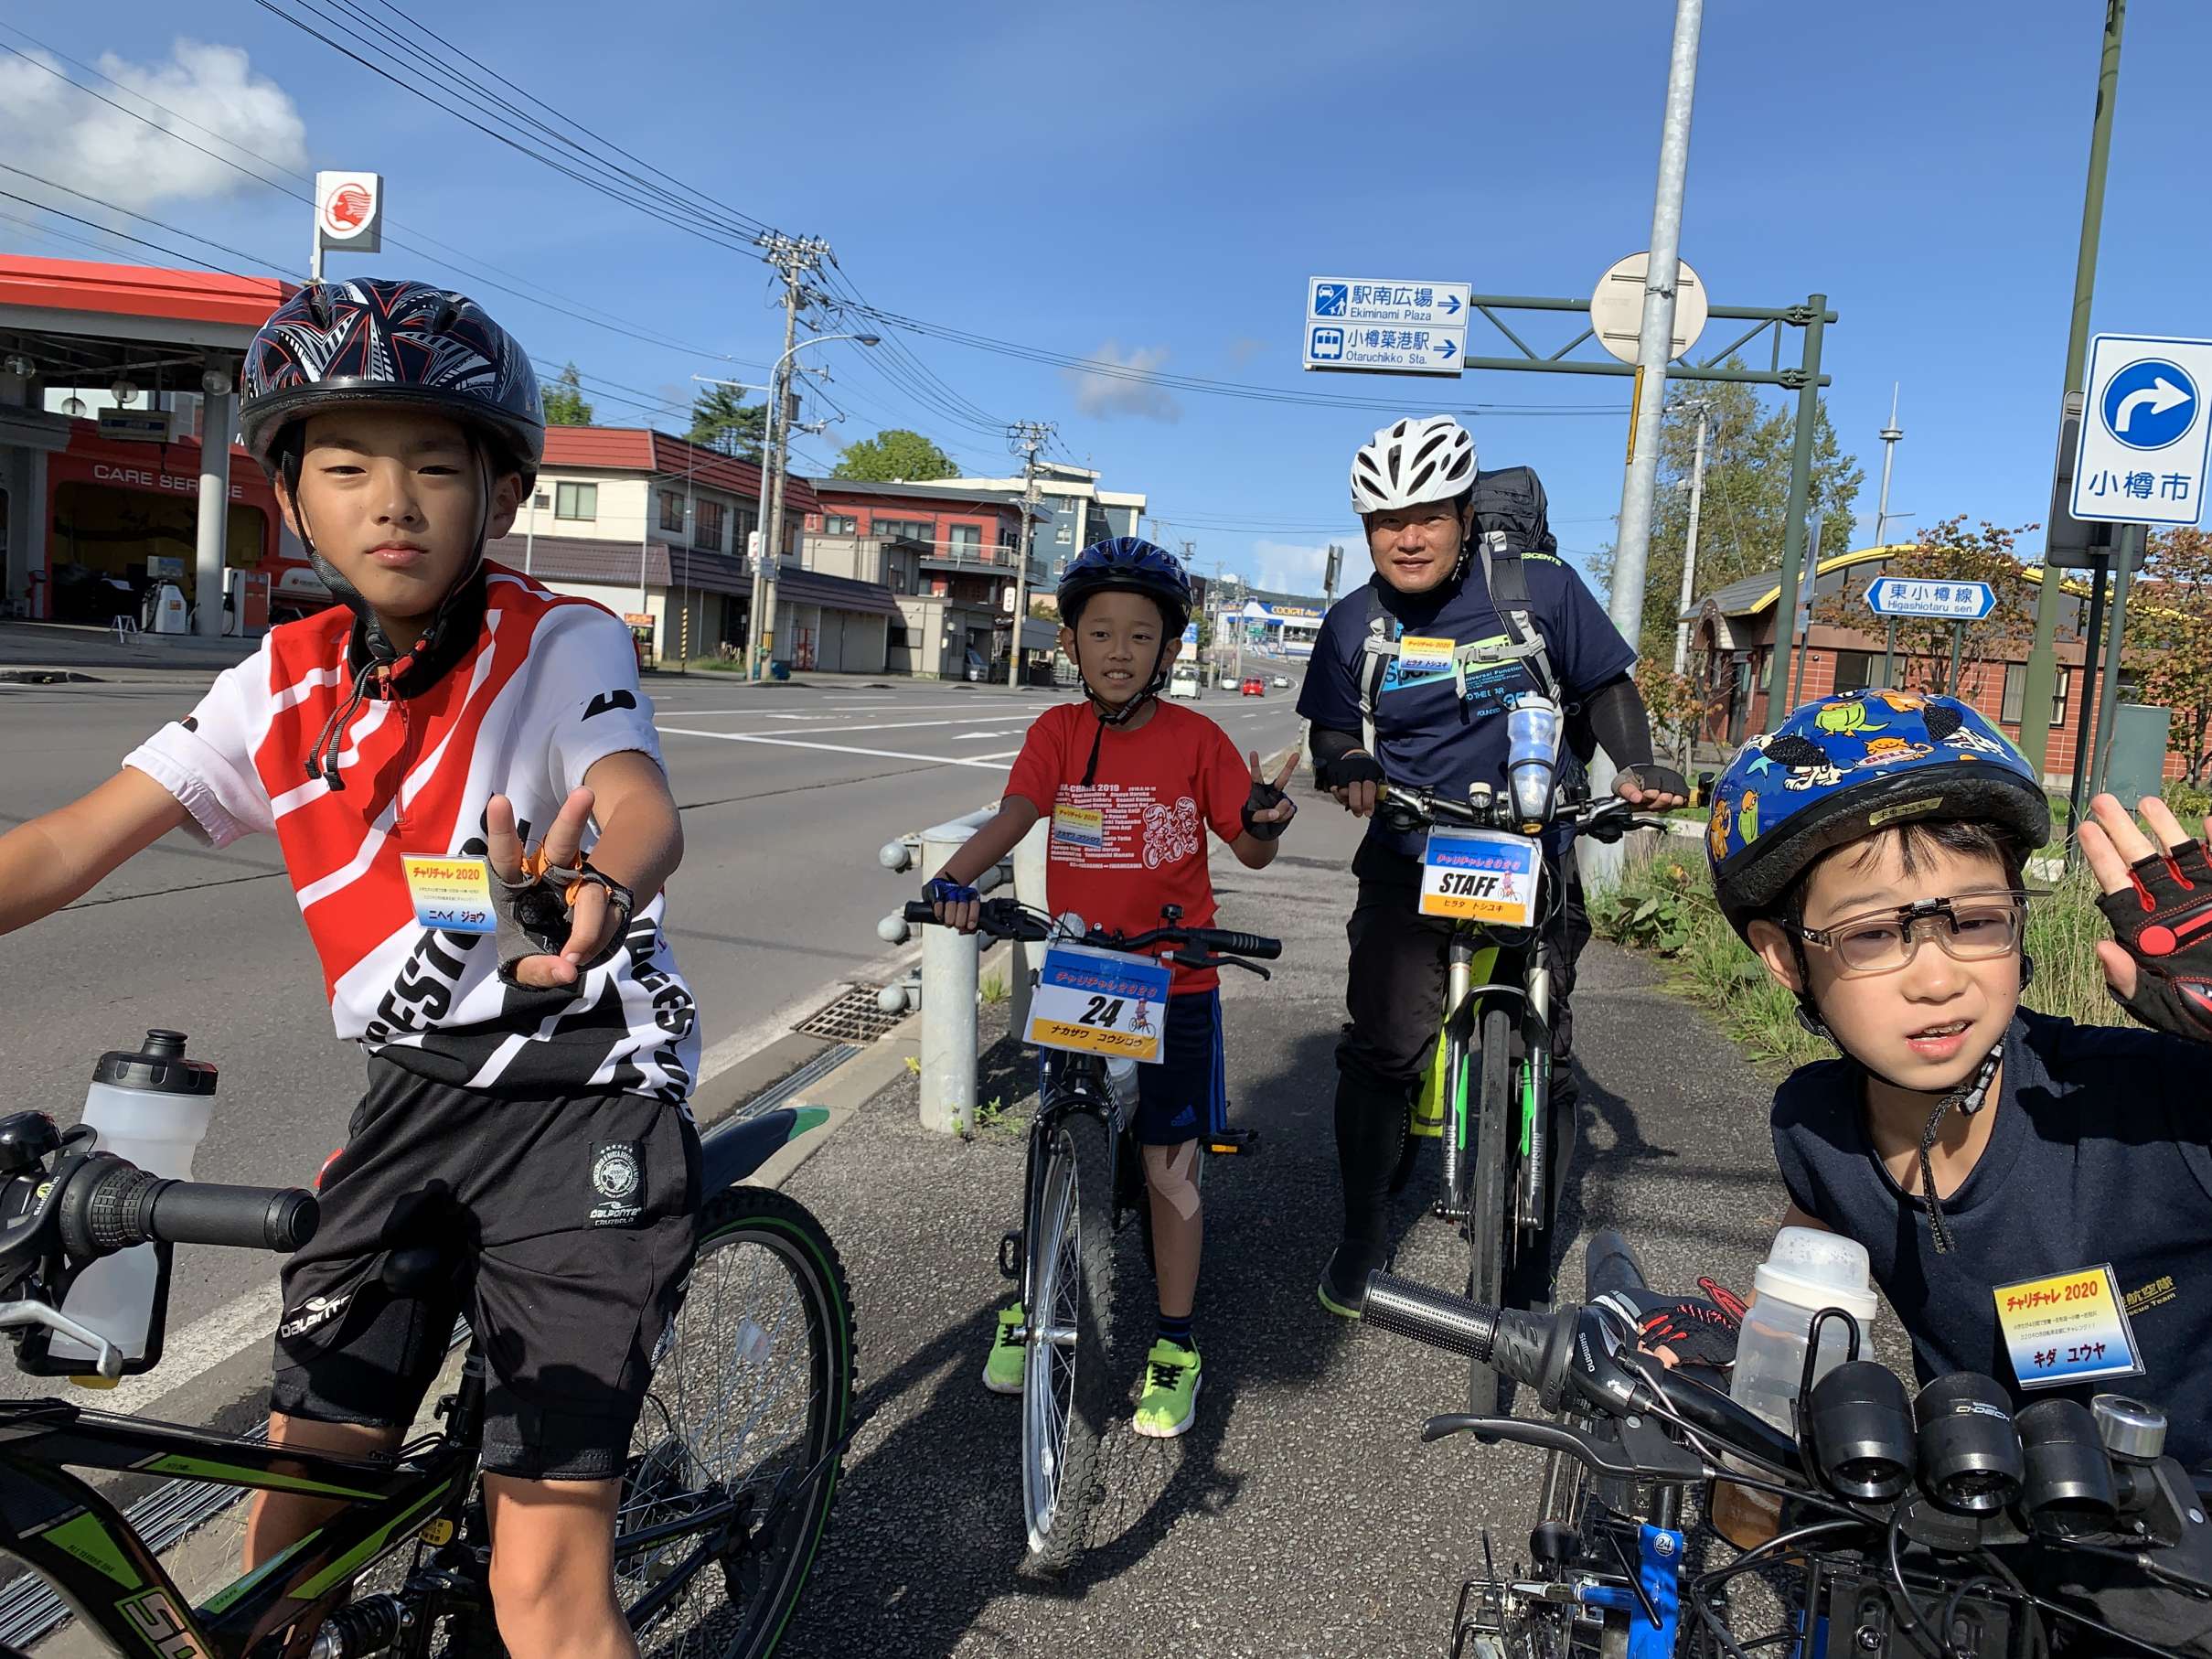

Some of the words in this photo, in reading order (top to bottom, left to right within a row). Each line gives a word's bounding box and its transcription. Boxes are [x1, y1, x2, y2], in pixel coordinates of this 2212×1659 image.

[1352, 285, 1434, 308] 駅南広場
[1351, 307, 1400, 320] Ekiminami
[1404, 309, 1433, 321] Plaza
[1348, 329, 1430, 351] 小樽築港駅
[1346, 351, 1404, 364] Otaruchikko
[1409, 353, 1427, 365] Sta.
[93, 464, 153, 487] CARE
[159, 475, 243, 499] SERE
[2089, 469, 2192, 501] 小樽市
[1520, 551, 1563, 567] ESCENTE
[1889, 583, 1973, 604] 東小樽線
[1887, 600, 1950, 613] Higashiotaru
[1954, 605, 1973, 614] sen
[1464, 670, 1492, 683] niversal
[1865, 750, 1907, 765] BELL
[412, 866, 454, 879] チャリチャレ
[455, 868, 480, 881] 2020
[1439, 872, 1500, 897] STAFF
[429, 910, 454, 923] ニヘイ
[461, 911, 486, 924] ジョウ
[1444, 899, 1466, 907] ヒラタ
[1472, 902, 1504, 913] トシユキ
[1078, 995, 1125, 1028] 24
[1051, 1024, 1090, 1039] ナカザワ
[1097, 1033, 1143, 1047] コウシロウ
[33, 1175, 60, 1216] SHIMANO
[2006, 1289, 2062, 1312] チャリチャレ
[2065, 1280, 2099, 1301] 2020
[2121, 1275, 2175, 1309] 航空隊
[2150, 1292, 2176, 1308] Team
[1578, 1332, 1596, 1373] SHIMANO
[2034, 1347, 2057, 1369] キダ
[2067, 1341, 2107, 1364] ユウヤ
